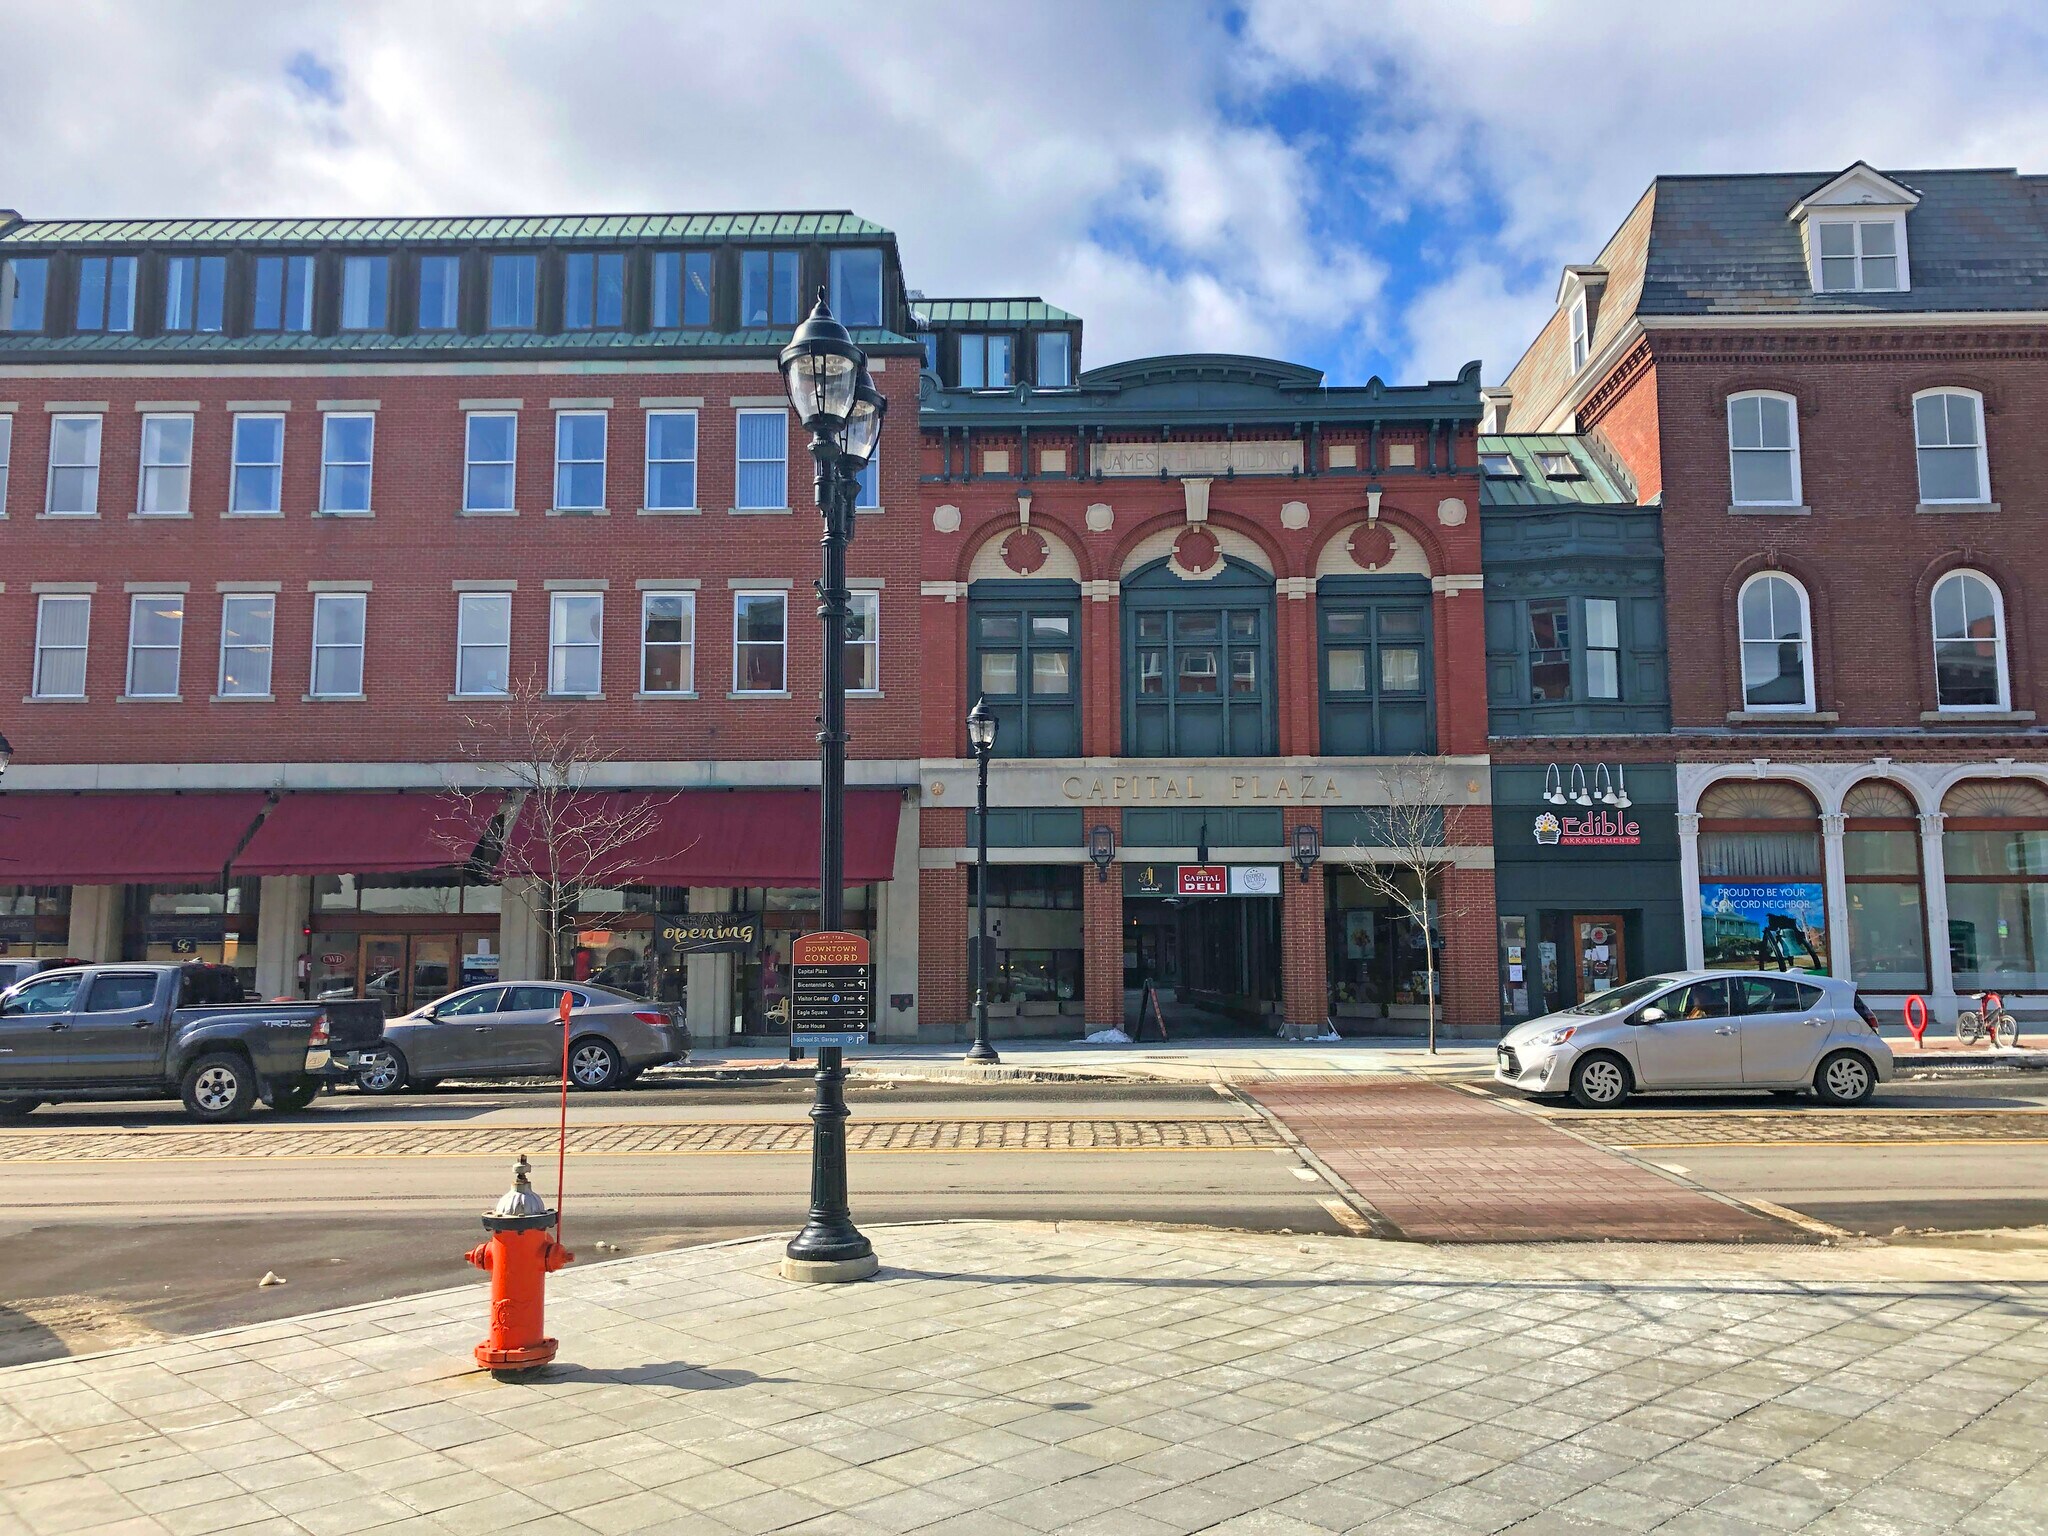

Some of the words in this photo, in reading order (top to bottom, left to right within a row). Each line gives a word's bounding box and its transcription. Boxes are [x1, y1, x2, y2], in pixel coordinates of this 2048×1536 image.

[1104, 452, 1155, 470] JAMES
[1180, 452, 1213, 469] HILL
[1062, 776, 1204, 799] CAPITAL
[1231, 776, 1342, 799] PLAZA
[1562, 811, 1640, 836] Edible
[1718, 888, 1750, 897] PROUD
[1752, 888, 1765, 897] TO
[1767, 888, 1777, 897] BE
[1780, 888, 1806, 897] YOUR
[1712, 900, 1760, 909] CONCORD
[1763, 900, 1810, 909] NEIGHBOR
[674, 915, 738, 926] GRAND
[663, 925, 754, 943] opening
[322, 955, 342, 963] CWB
[804, 954, 858, 962] CONCORD
